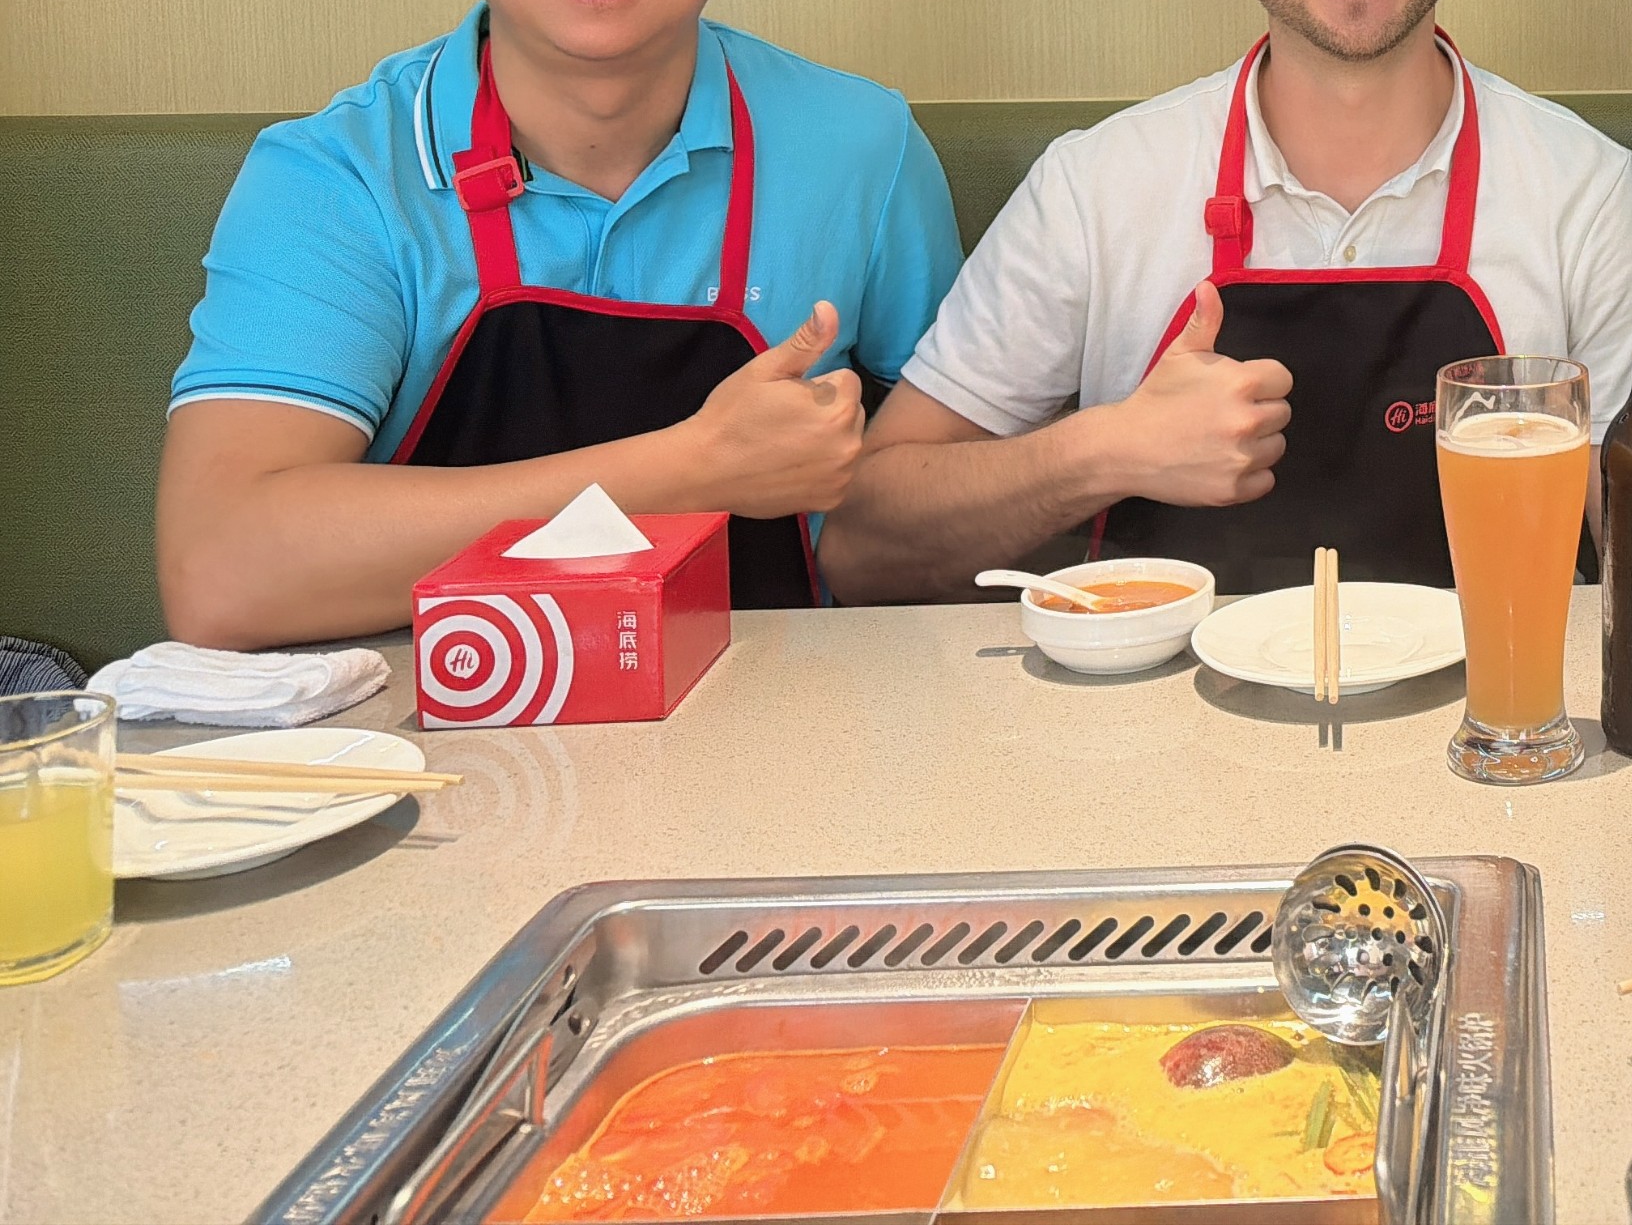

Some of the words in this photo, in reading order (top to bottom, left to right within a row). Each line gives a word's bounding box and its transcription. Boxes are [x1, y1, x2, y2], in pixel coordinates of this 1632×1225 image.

[707, 286, 762, 302] BS
[616, 610, 639, 671] 海底捞
